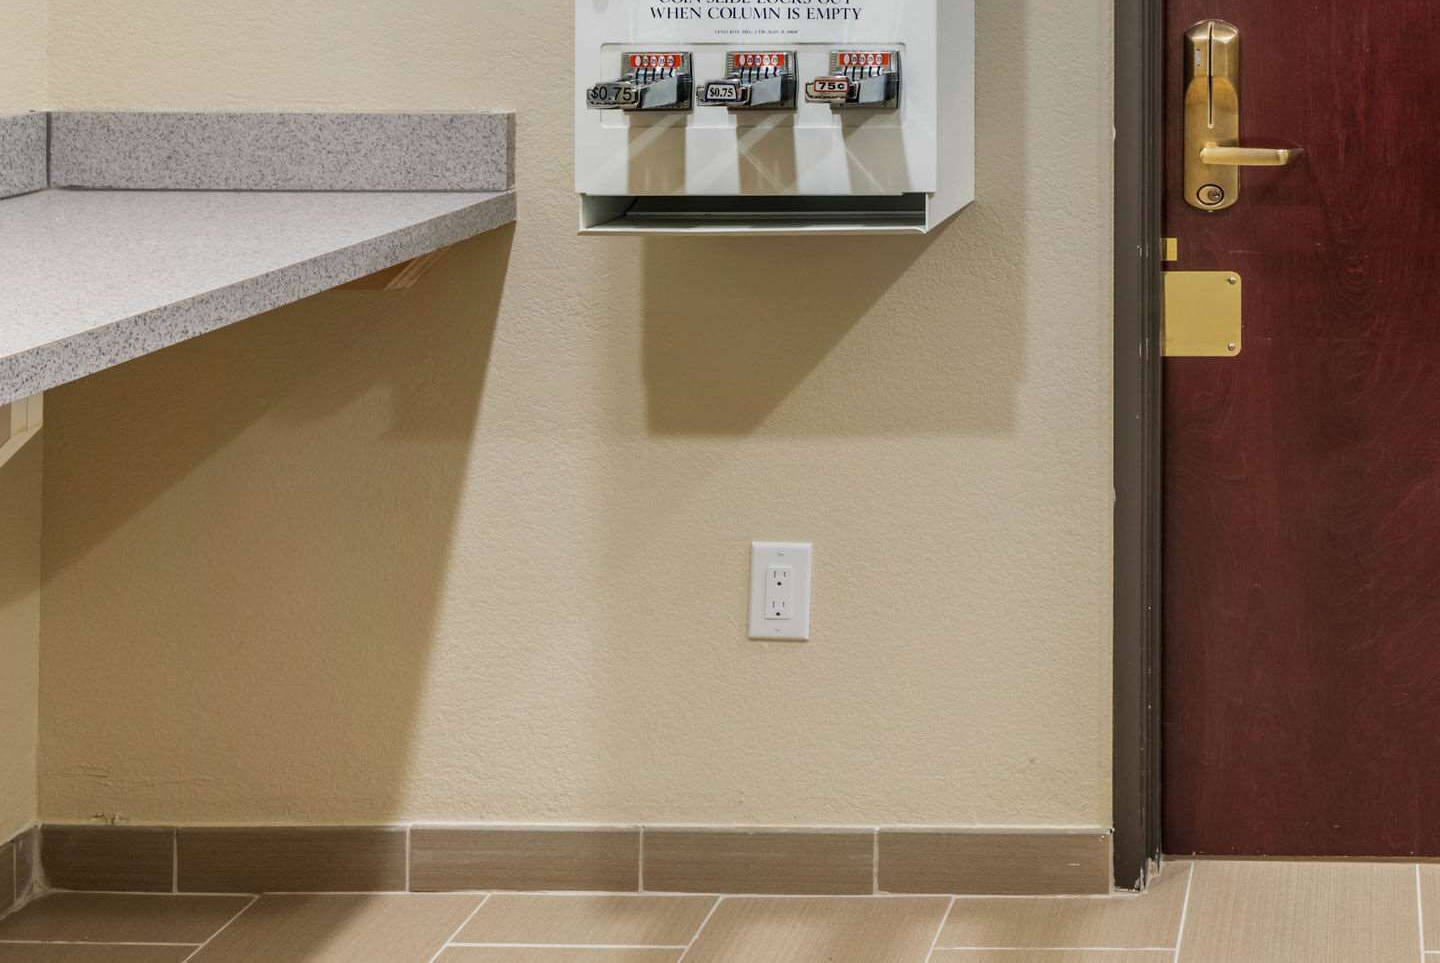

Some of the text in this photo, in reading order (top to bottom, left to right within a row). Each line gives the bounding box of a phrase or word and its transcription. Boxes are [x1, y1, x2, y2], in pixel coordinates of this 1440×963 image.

[650, 6, 863, 20] WHEN COLUMN IS EMPTY
[591, 86, 633, 102] $0.75
[708, 87, 734, 98] $0.75
